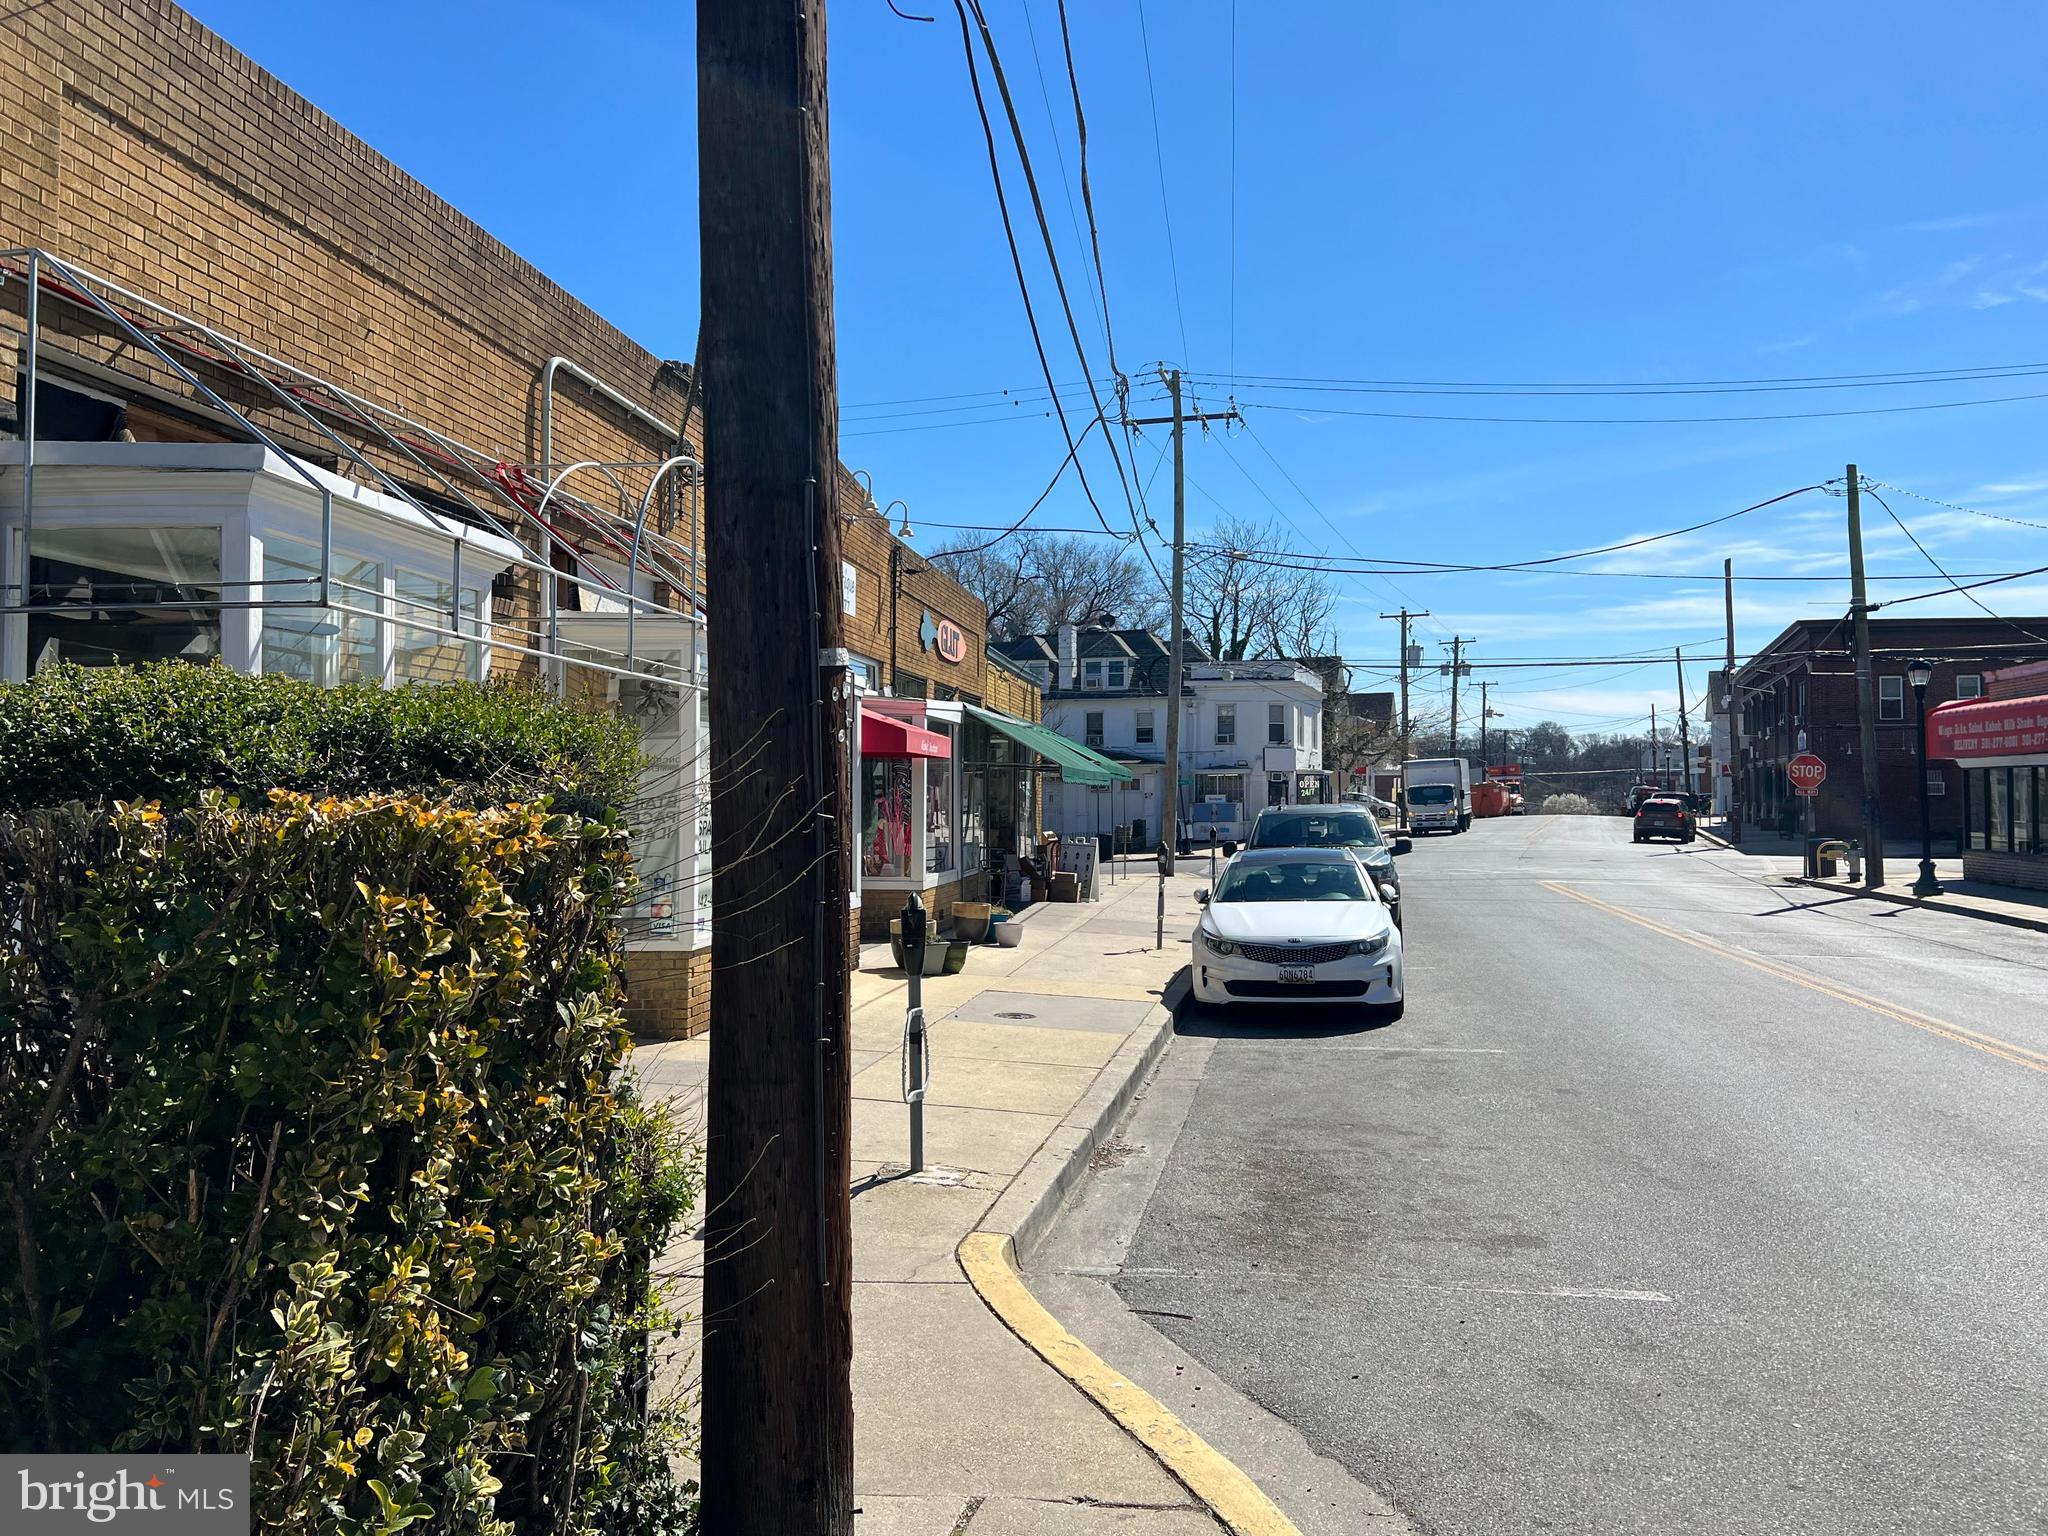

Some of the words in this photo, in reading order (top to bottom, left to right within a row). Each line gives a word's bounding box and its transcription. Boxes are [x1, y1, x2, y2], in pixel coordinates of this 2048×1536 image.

[941, 625, 960, 658] GLUT
[1792, 766, 1822, 777] STOP
[1299, 780, 1320, 788] OPEN
